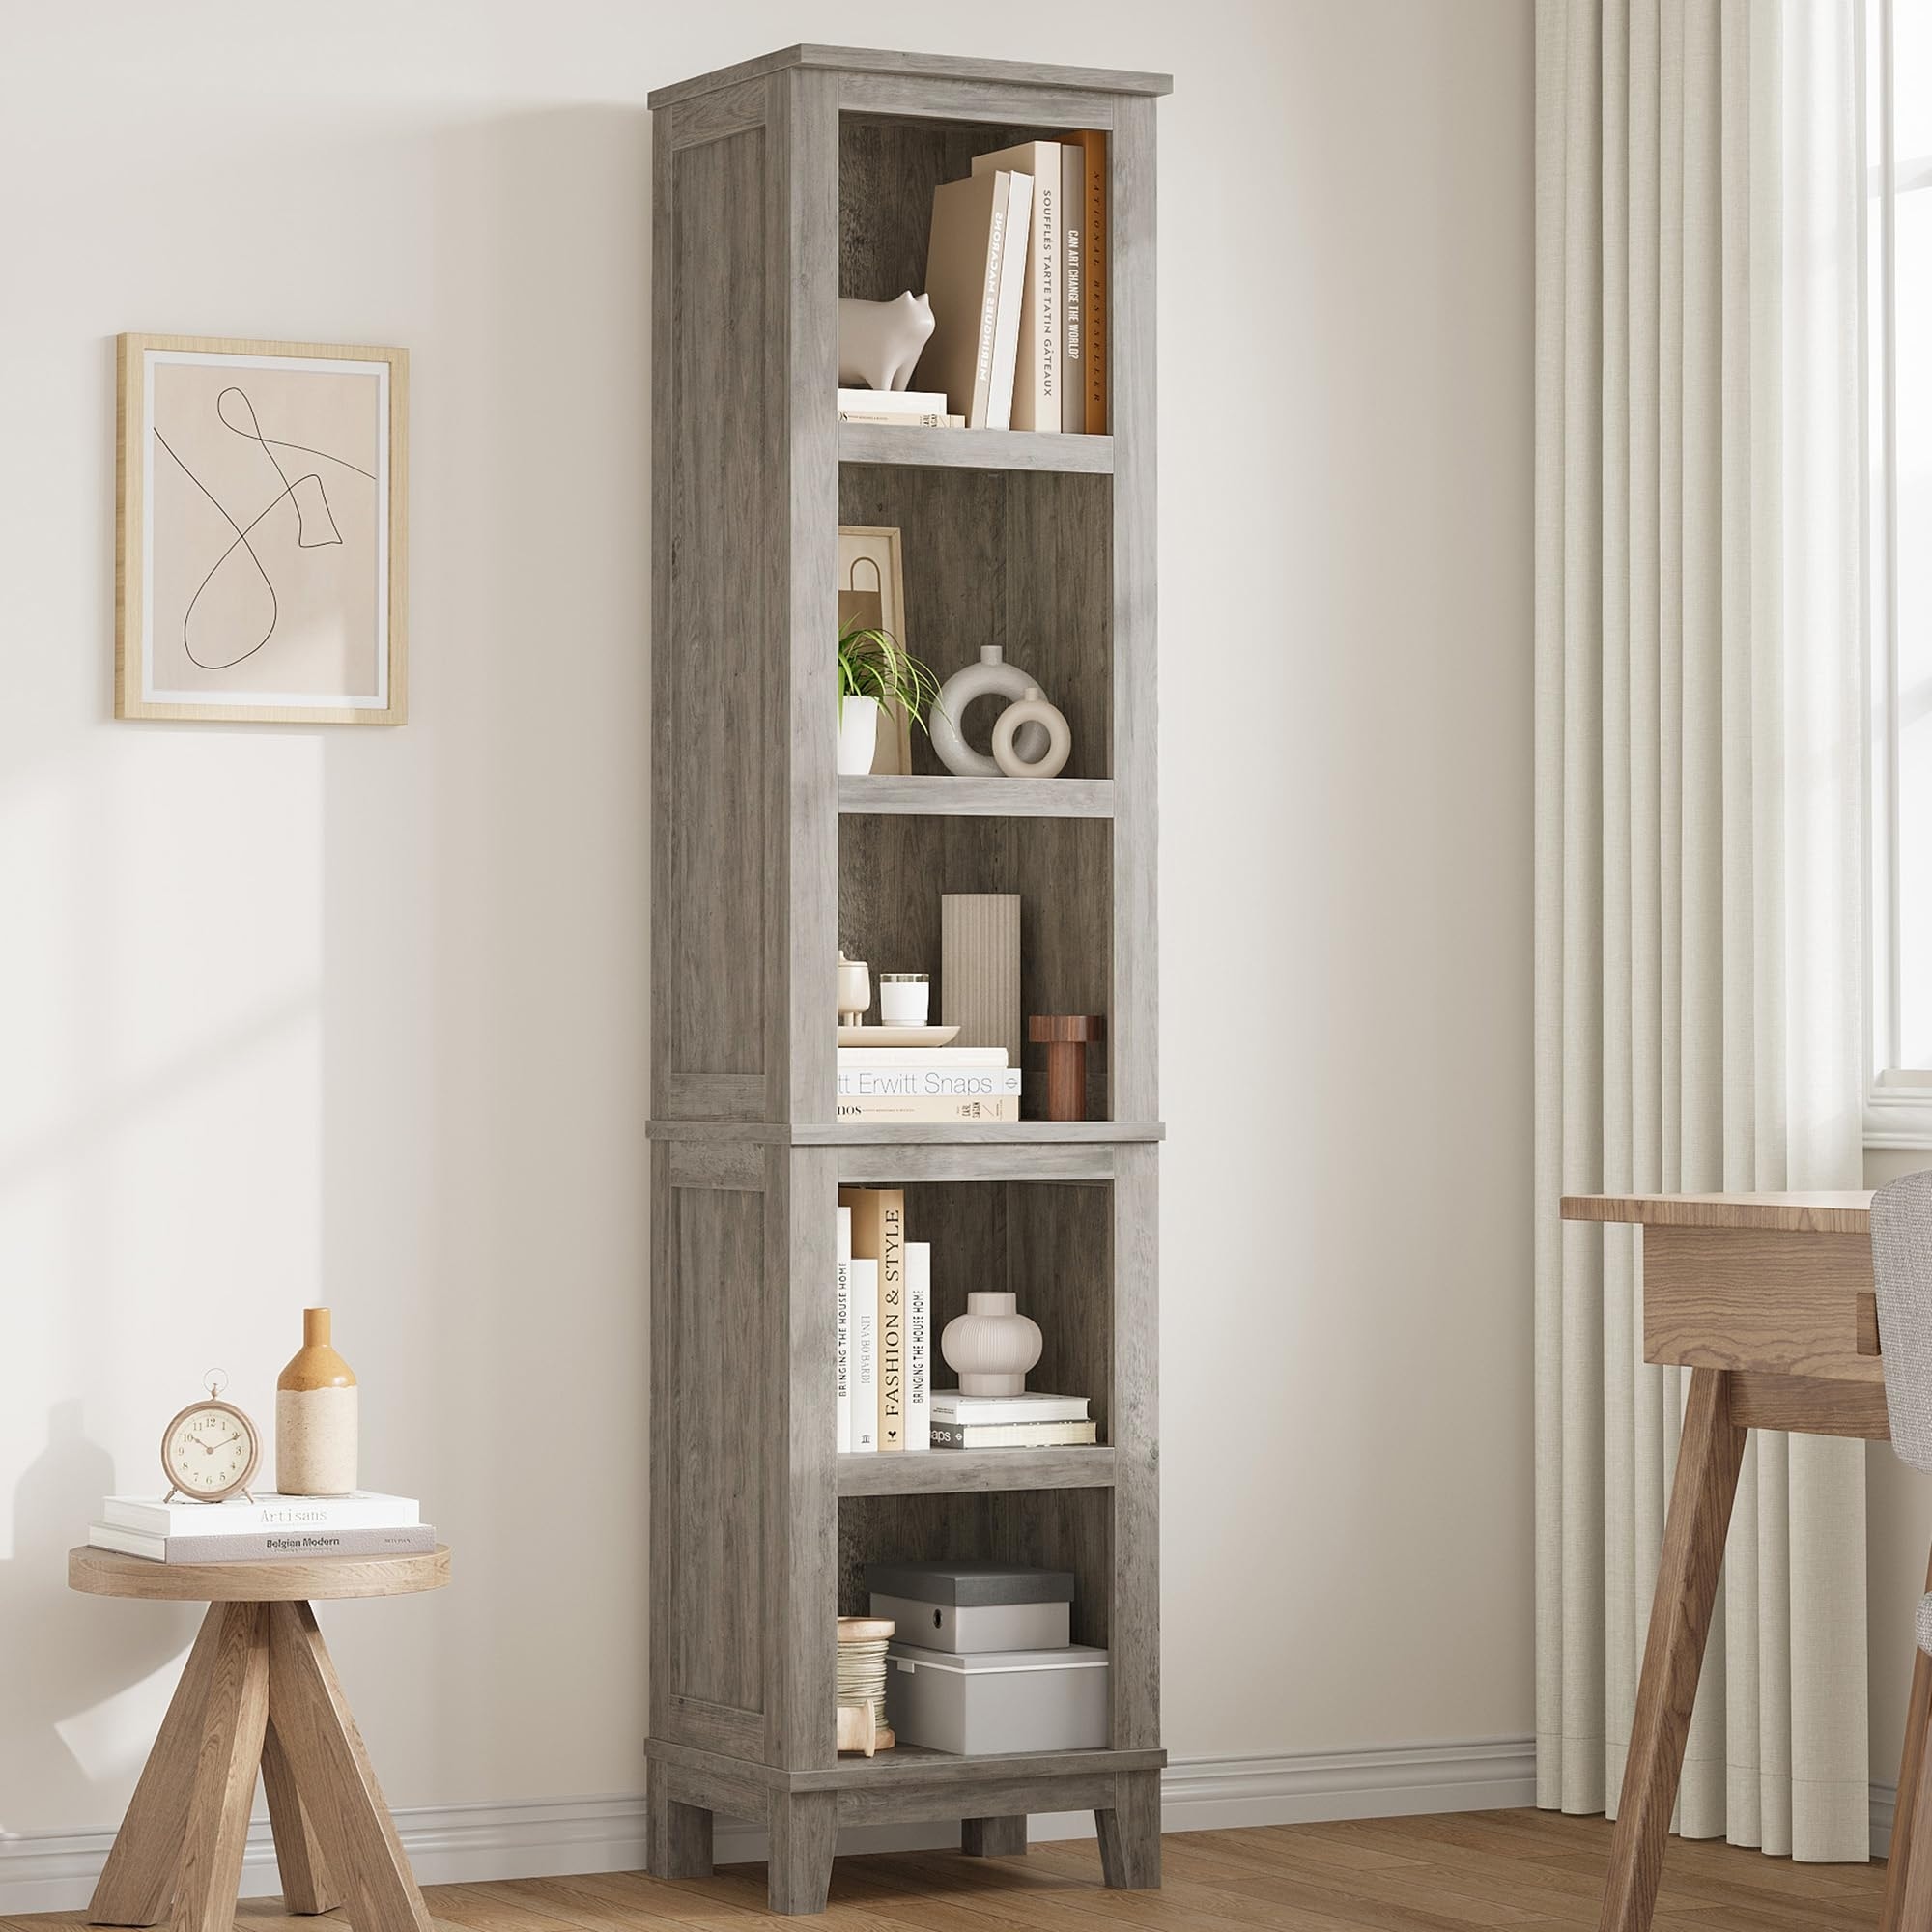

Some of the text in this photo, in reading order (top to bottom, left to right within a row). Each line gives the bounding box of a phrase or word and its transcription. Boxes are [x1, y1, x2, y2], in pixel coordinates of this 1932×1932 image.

[1042, 189, 1054, 397] SOUFFLÉS TARTE TATIN GÂTEAUX
[1067, 229, 1079, 360] CAN ART CHANGE THE WORLD?
[859, 1072, 918, 1094] Erwitt
[924, 1072, 992, 1096] Snaps
[885, 1209, 899, 1416] FASHION & STYLE
[838, 1262, 847, 1397] BRINGING THE HOUSE HOME
[861, 1315, 871, 1384] LINA BO BARDI
[912, 1290, 924, 1404] BRINGING THE HOUSE HOME
[193, 1422, 203, 1431] 11
[206, 1417, 216, 1428] 12
[221, 1421, 226, 1431] 1
[184, 1434, 194, 1443] 10
[178, 1447, 185, 1456] 9
[235, 1446, 242, 1456] 3
[182, 1462, 189, 1471] 8
[193, 1472, 199, 1482] 7
[205, 1475, 213, 1485] 6
[219, 1471, 226, 1482] 5
[260, 1508, 328, 1523] Artisans
[266, 1536, 340, 1549] Belgian Modern
